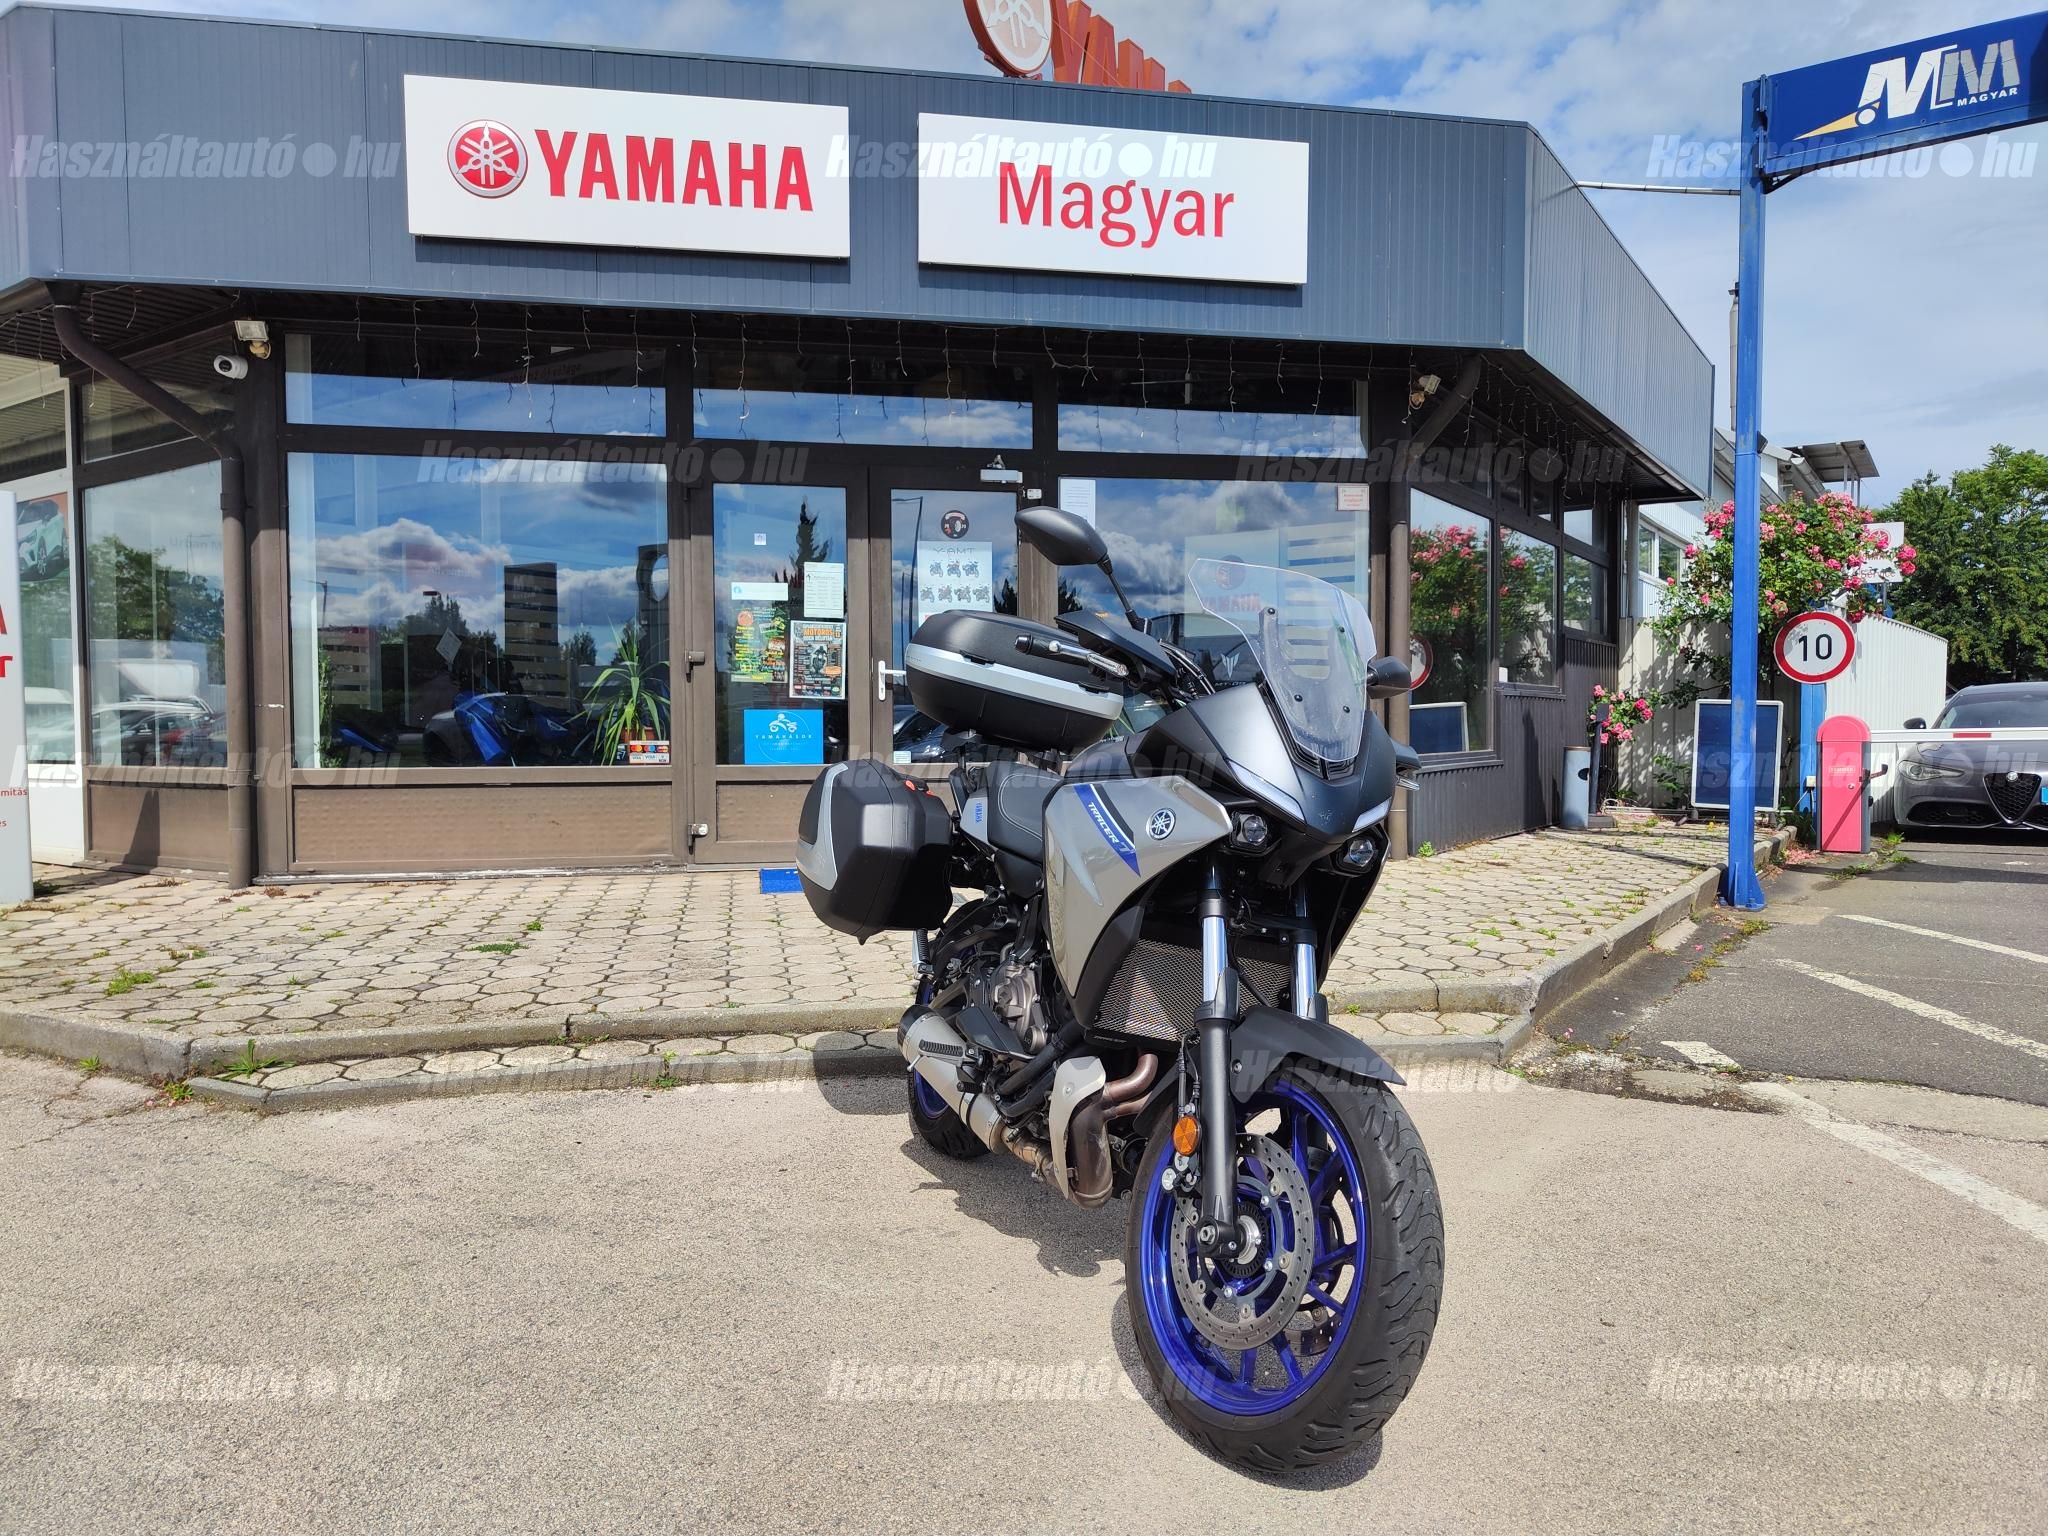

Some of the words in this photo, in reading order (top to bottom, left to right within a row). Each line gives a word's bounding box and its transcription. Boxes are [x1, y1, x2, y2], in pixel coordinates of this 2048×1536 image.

[1957, 87, 2018, 107] MAGYAR
[534, 129, 813, 211] YAMAHA
[1000, 161, 1234, 248] Magyar
[1799, 634, 1832, 661] 10
[1088, 801, 1120, 844] TRACER
[1119, 841, 1131, 852] 7
